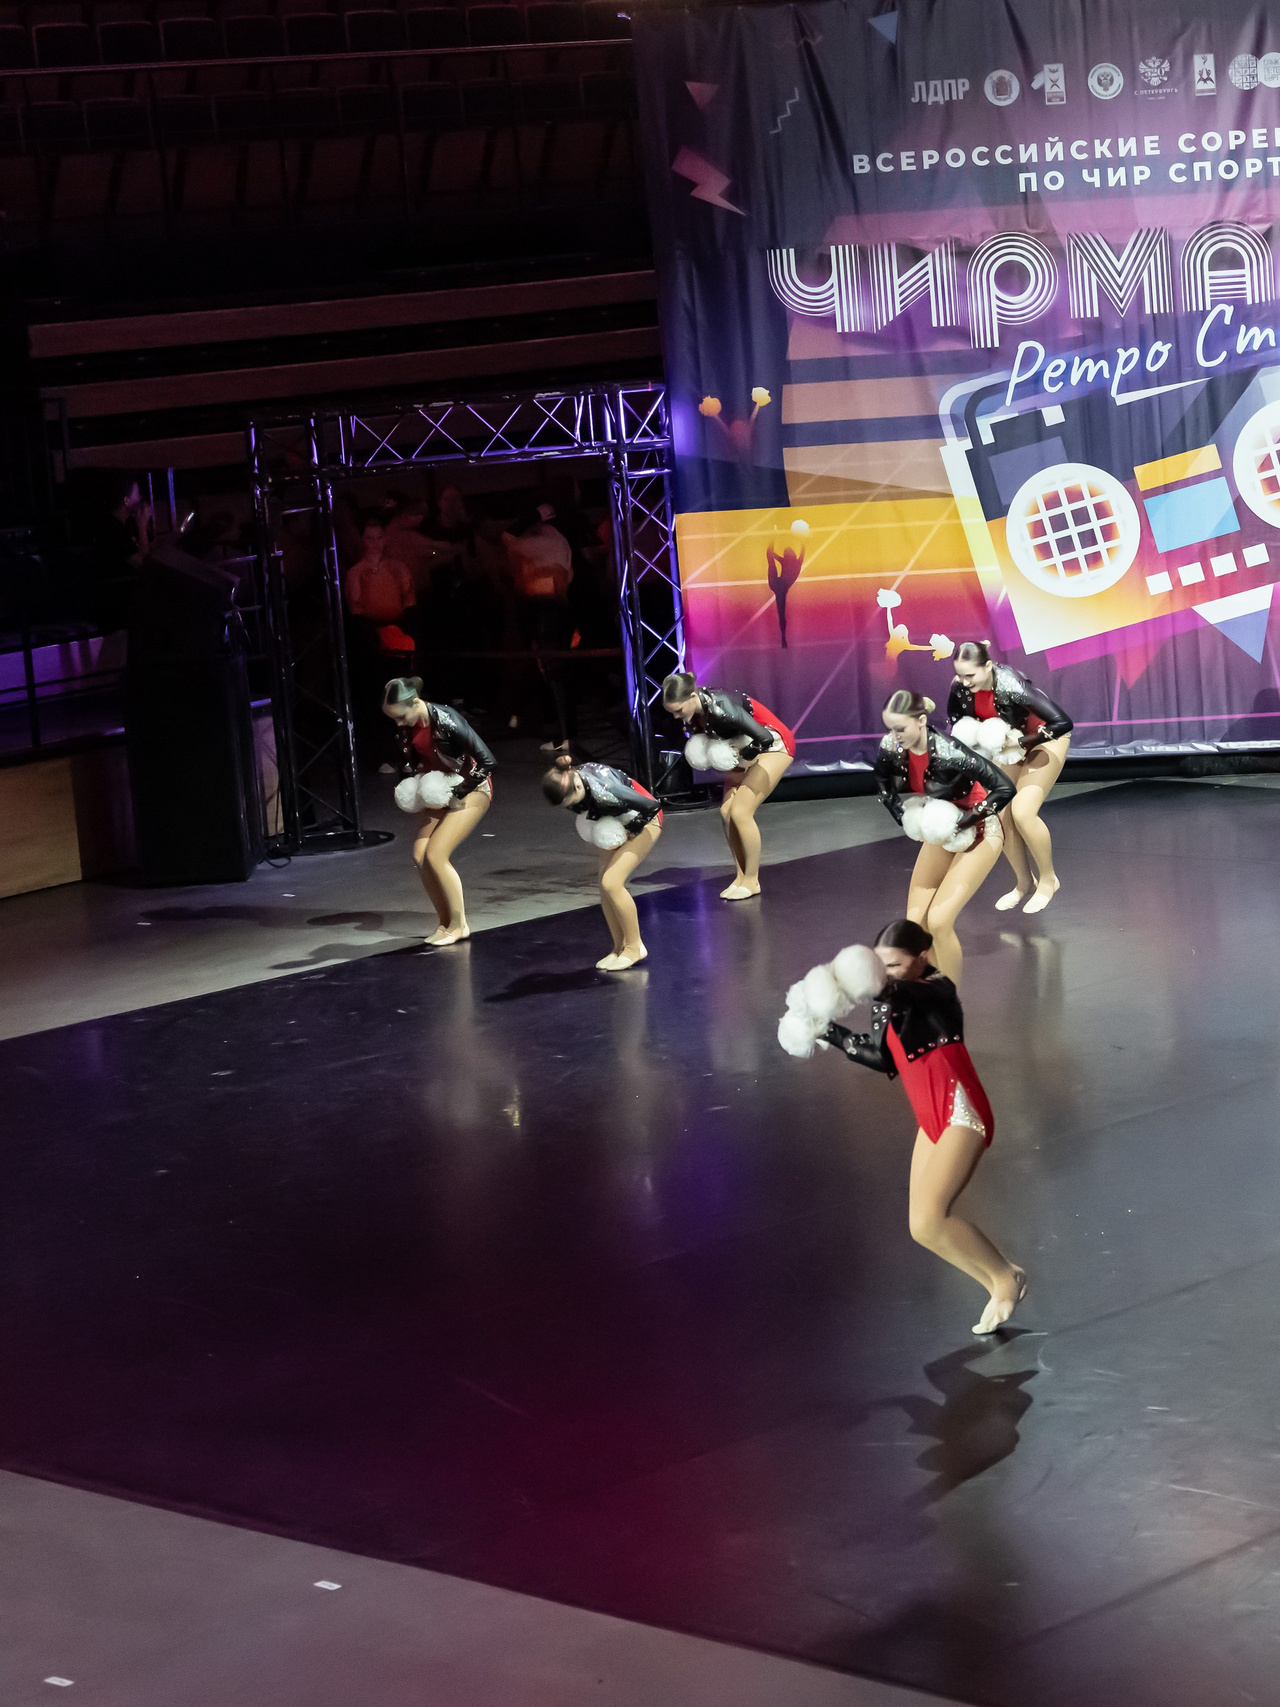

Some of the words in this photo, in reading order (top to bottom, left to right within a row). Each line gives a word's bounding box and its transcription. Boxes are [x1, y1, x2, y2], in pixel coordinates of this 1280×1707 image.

[911, 78, 970, 105] ЛДПР
[853, 135, 1160, 174] ВСЕРОССИЙСКИЕ
[1019, 171, 1064, 192] ПО
[1082, 165, 1151, 188] ЧИР
[1006, 341, 1172, 406] Ретро
